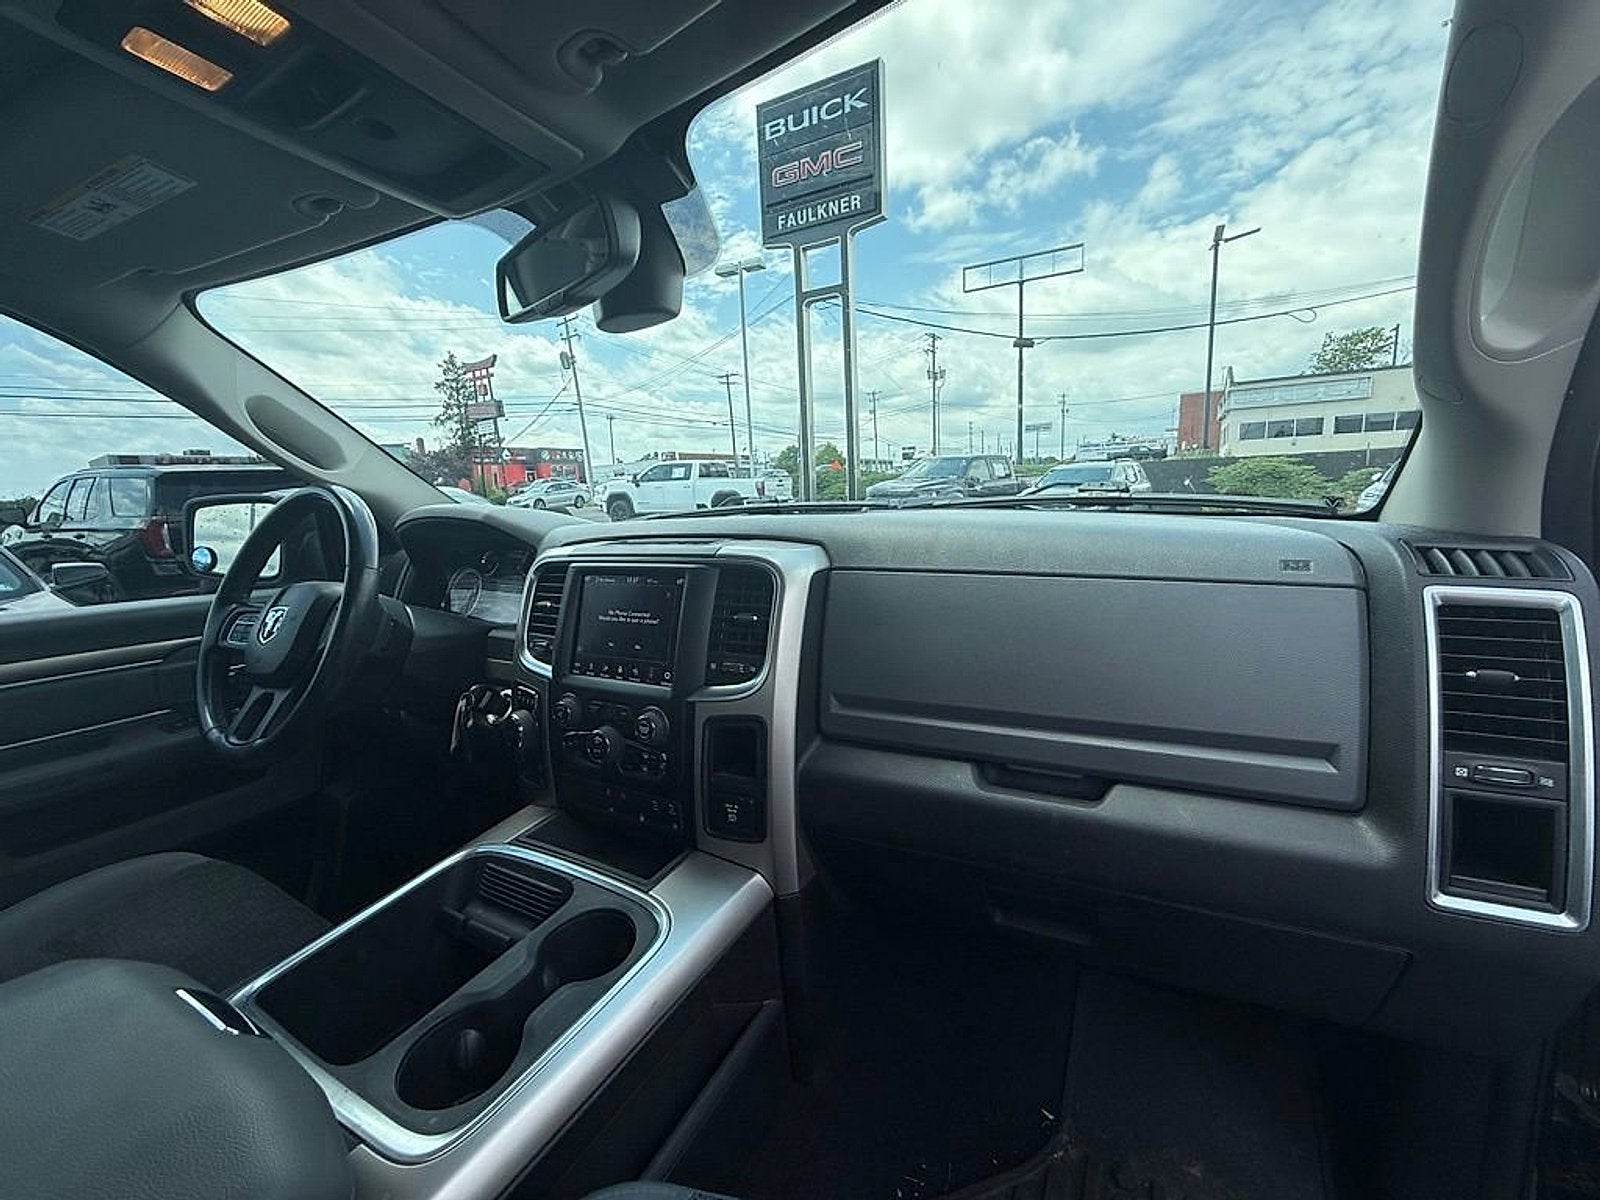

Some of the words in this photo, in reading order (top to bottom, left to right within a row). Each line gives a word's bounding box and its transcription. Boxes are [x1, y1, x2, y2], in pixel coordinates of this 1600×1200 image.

[764, 87, 869, 141] BUICK
[772, 140, 863, 188] GMC
[777, 195, 861, 231] FAULKNER
